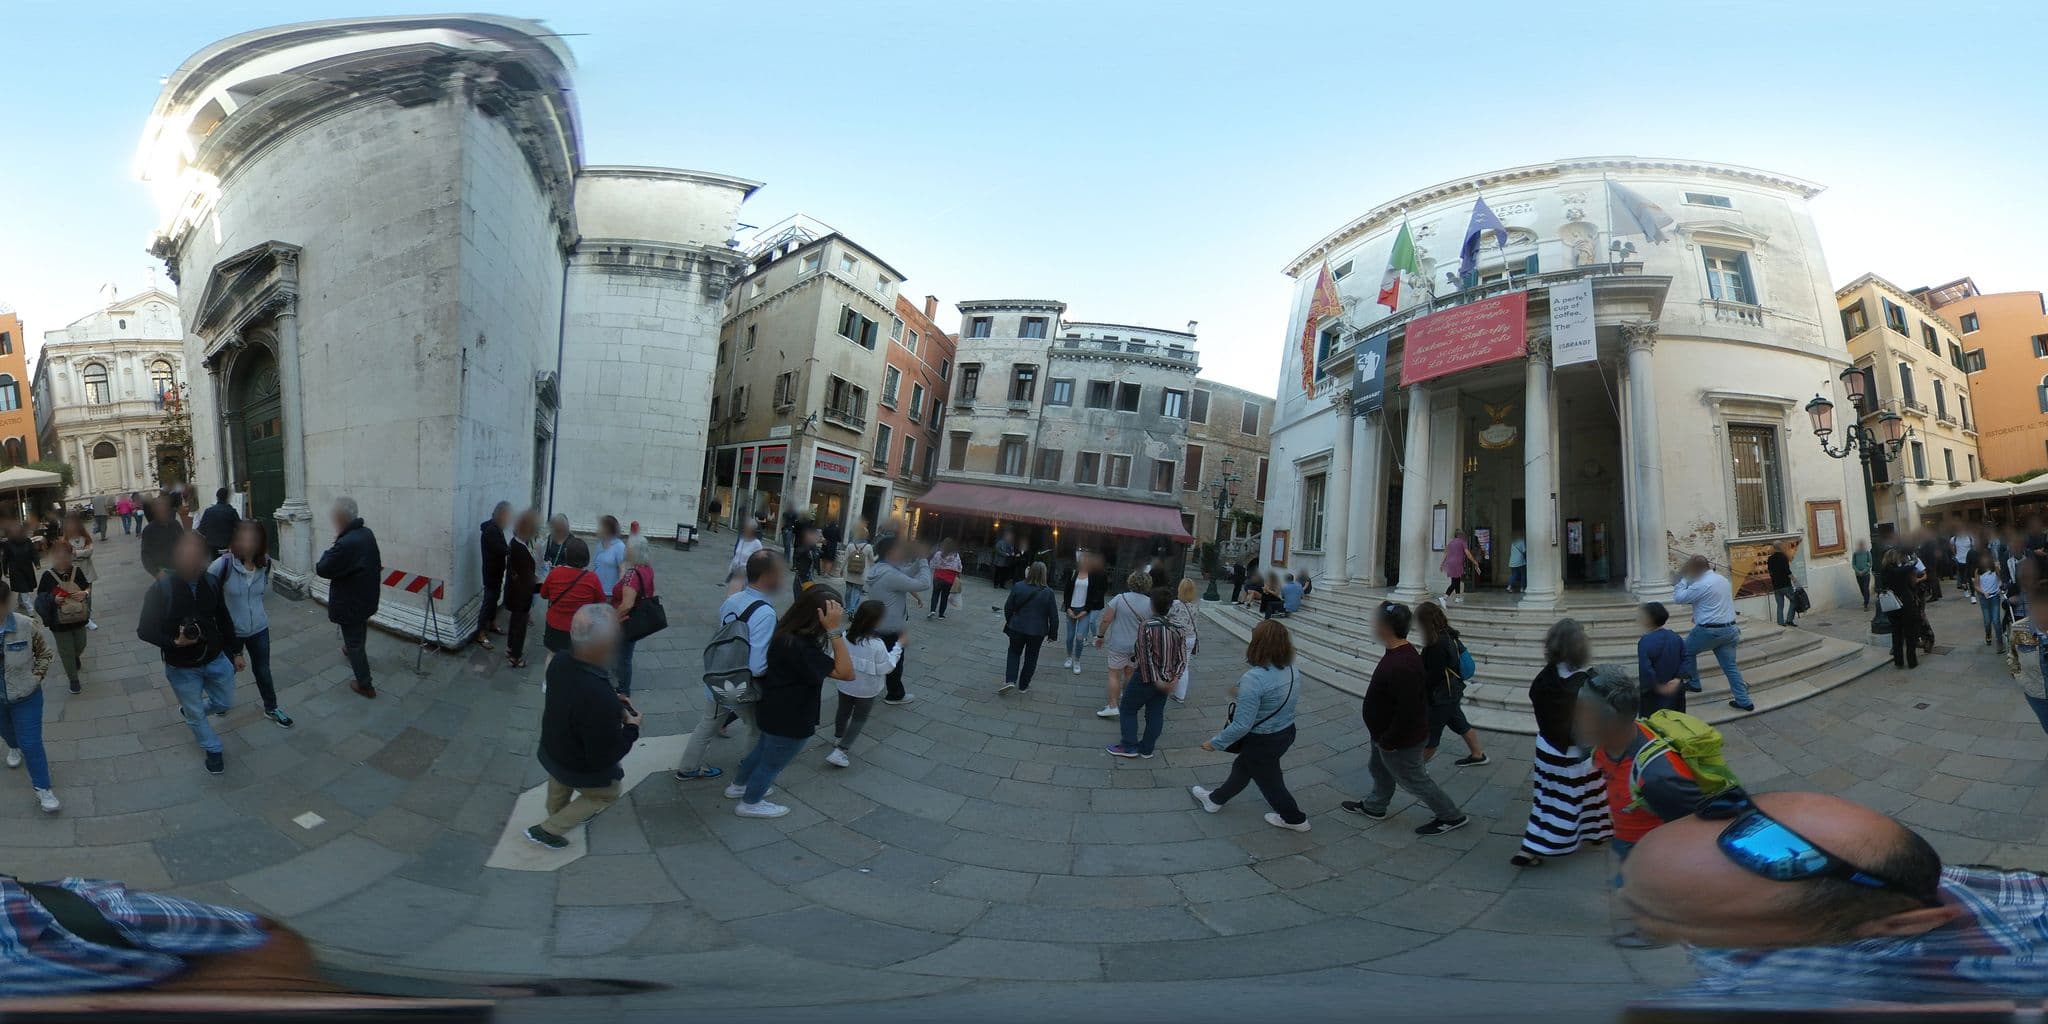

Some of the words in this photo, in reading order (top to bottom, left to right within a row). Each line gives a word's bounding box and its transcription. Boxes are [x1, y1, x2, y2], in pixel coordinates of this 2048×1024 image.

[1562, 291, 1588, 303] perfet
[1553, 305, 1569, 313] cup
[1554, 311, 1582, 320] coffee.
